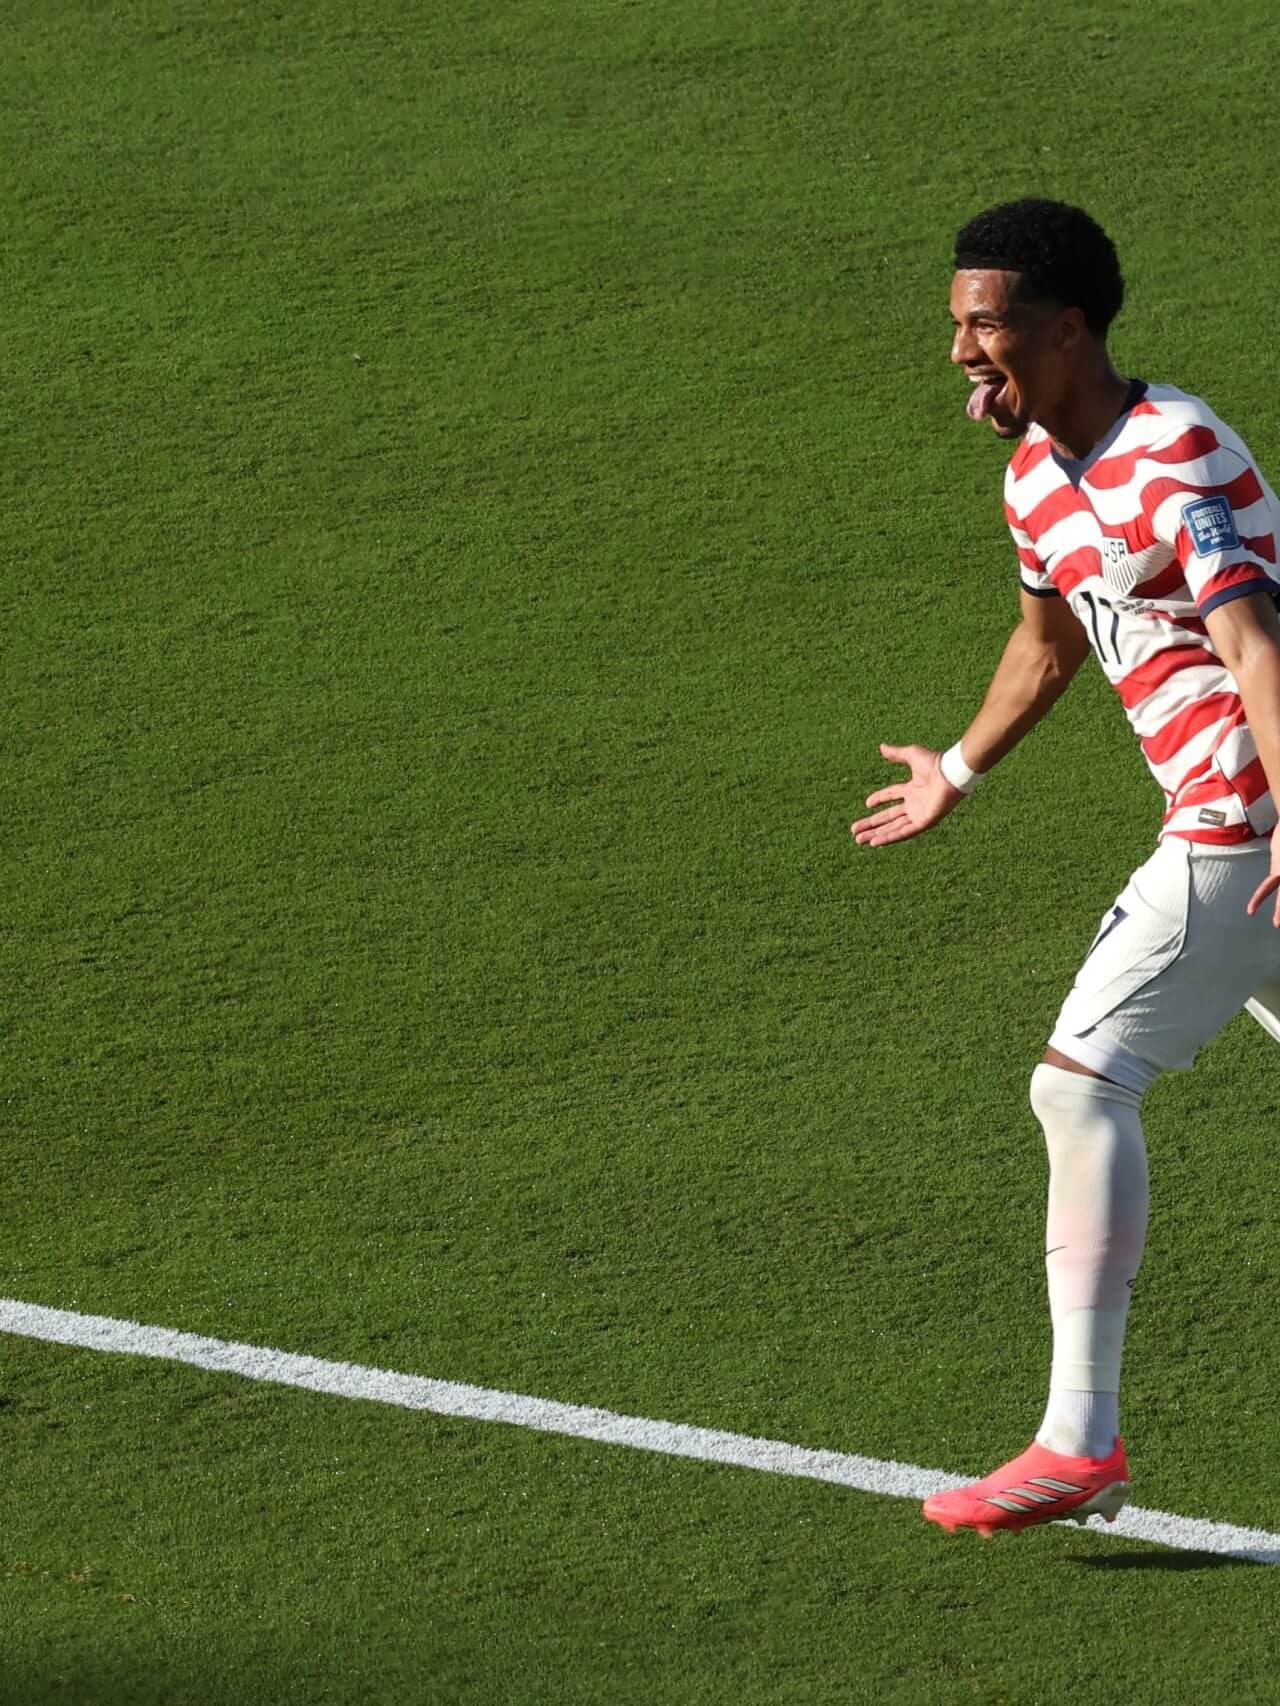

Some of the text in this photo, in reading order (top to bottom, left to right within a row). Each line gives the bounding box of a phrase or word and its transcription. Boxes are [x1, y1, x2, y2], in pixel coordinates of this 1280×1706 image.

[1191, 504, 1224, 519] FOOTBALL
[1195, 512, 1227, 530] UNITES
[1103, 541, 1126, 563] USA
[1079, 591, 1122, 665] 17
